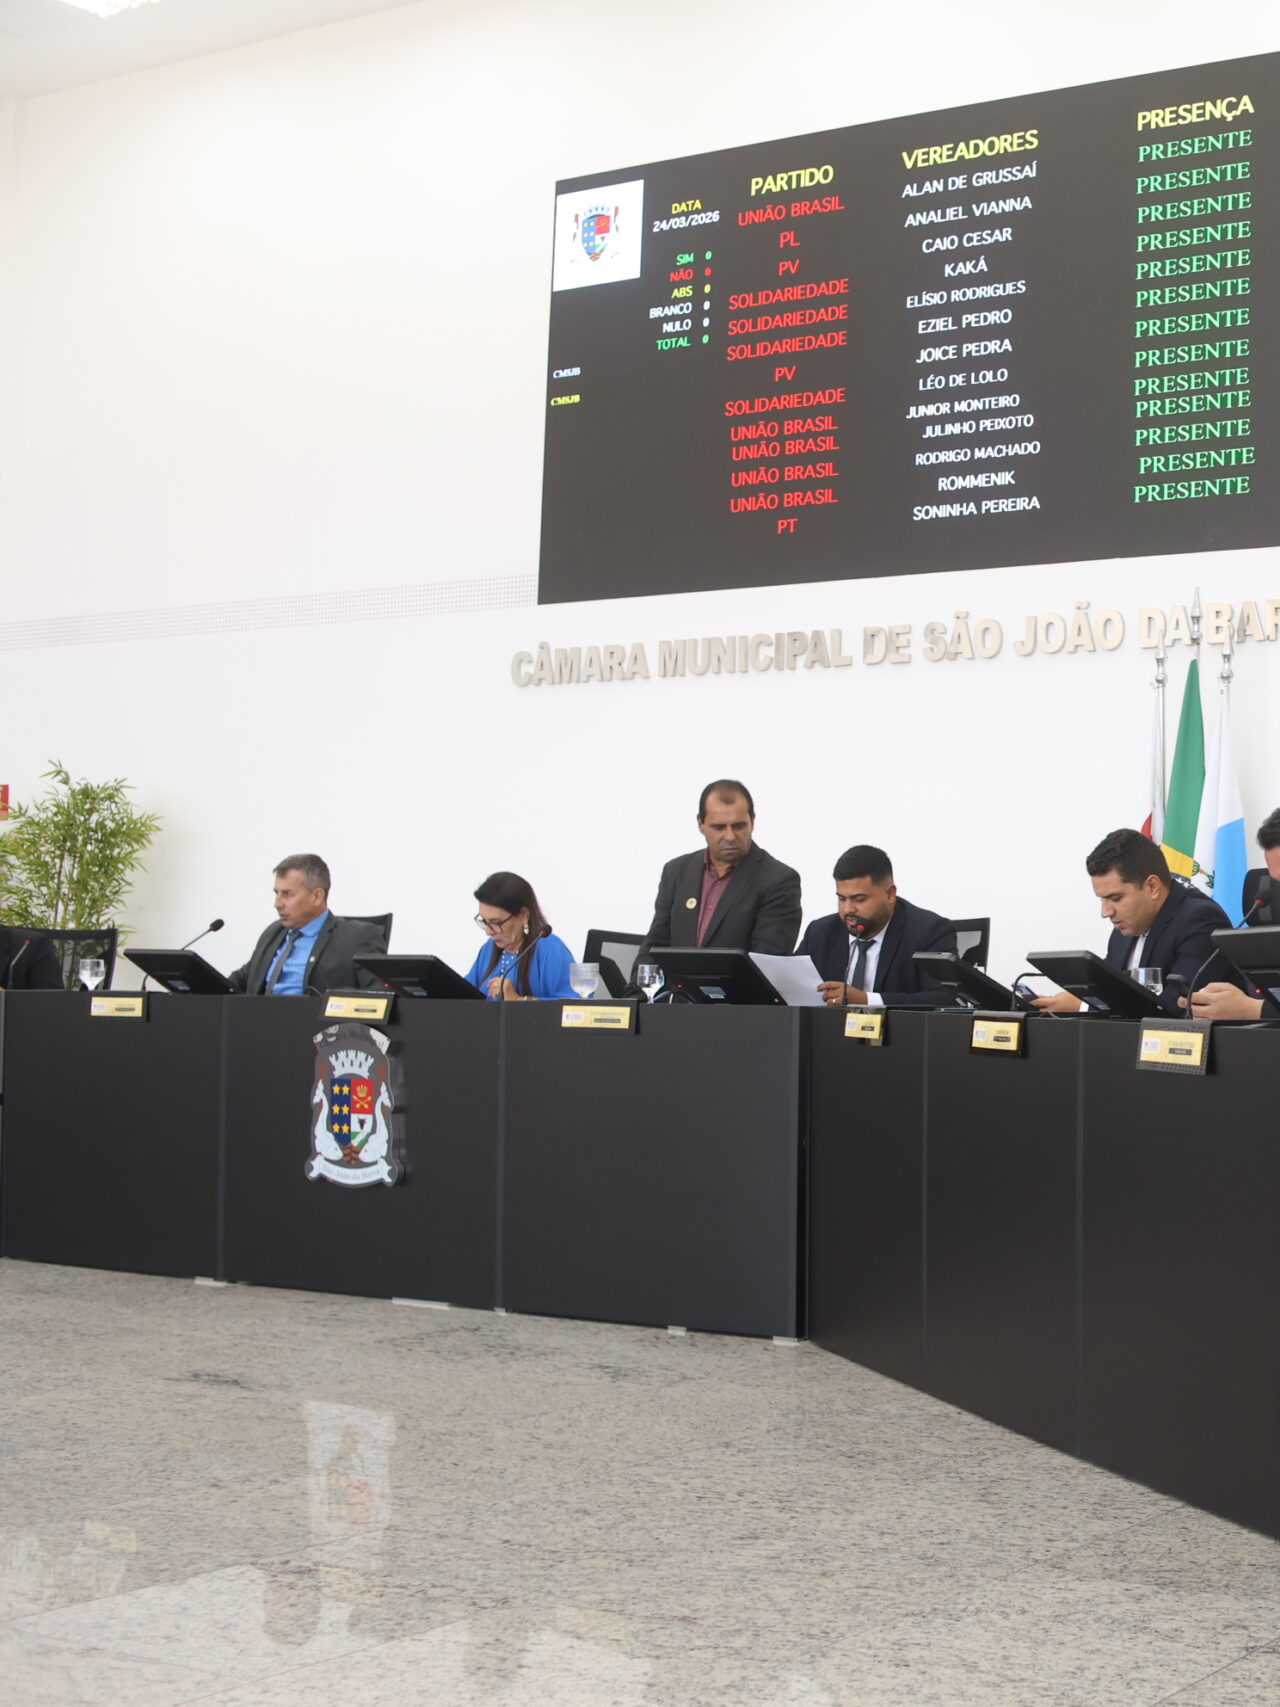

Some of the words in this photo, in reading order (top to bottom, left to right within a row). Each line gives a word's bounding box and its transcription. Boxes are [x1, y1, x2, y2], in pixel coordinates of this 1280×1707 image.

[1137, 95, 1254, 131] PRESENÇA
[902, 129, 1038, 169] VEREADORES
[1138, 130, 1252, 162] PRESENTE
[751, 165, 834, 196] PARTIDO
[902, 179, 944, 198] ALAN
[948, 175, 967, 190] DE
[972, 160, 1037, 186] GRUSSAÍ
[1136, 162, 1250, 194] PRESENTE
[672, 199, 701, 214] DATA
[738, 204, 787, 226] UNIÃO
[790, 196, 845, 217] BRASIL
[904, 206, 968, 227] ANALIEL
[972, 196, 1032, 216] VIANNA
[1138, 192, 1252, 223] PRESENTE
[653, 210, 720, 232] 24/03/2026
[779, 231, 801, 248] PL
[922, 235, 958, 253] CAIO
[963, 227, 1012, 247] CESAR
[1136, 221, 1251, 252] PRESENTE
[676, 253, 694, 265] SIM
[705, 251, 712, 260] 0
[778, 259, 800, 276] PV
[945, 255, 988, 277] KAKÁ
[1136, 249, 1251, 280] PRESENTE
[670, 268, 695, 282] NÃO
[705, 267, 712, 276] 0
[671, 285, 693, 298] ABS
[704, 284, 711, 293] 0
[729, 278, 849, 310] SOLIDARIEDADE
[906, 291, 947, 308] ELÍSIO
[951, 280, 1026, 302] RODRIGUES
[1136, 278, 1250, 307] PRESENTE
[649, 302, 692, 319] BRANCO
[703, 301, 710, 310] 0
[728, 304, 848, 335] SOLIDARIEDADE
[918, 317, 958, 334] EZIEL
[962, 309, 1012, 328] PEDRO
[1135, 308, 1250, 338] PRESENTE
[663, 319, 692, 333] NULO
[703, 317, 709, 327] 0
[656, 336, 691, 350] TOTAL
[702, 334, 709, 344] 0
[726, 331, 848, 360] SOLIDARIEDADE
[916, 345, 958, 363] JOICE
[962, 339, 1012, 357] PEDRA
[1135, 339, 1250, 368] PRESENTE
[553, 367, 581, 378] CMSJB
[775, 366, 797, 382] PV
[919, 374, 945, 390] LÉO
[949, 373, 967, 387] DE
[971, 368, 1008, 384] LOLO
[1134, 368, 1249, 396] PRESENTE
[551, 395, 580, 406] CMSJB
[724, 387, 846, 416] SOLIDARIEDADE
[906, 402, 951, 419] JUNIOR
[954, 394, 1020, 413] MONTEIRO
[1136, 390, 1251, 418] PRESENTE
[731, 421, 780, 441] UNIÃO
[783, 416, 838, 435] BRASIL
[922, 420, 976, 438] JULINHO
[979, 414, 1034, 431] PEIXOTO
[1136, 419, 1251, 446] PRESENTE
[732, 441, 782, 461] UNIÃO
[785, 435, 840, 455] BRASIL
[916, 448, 971, 465] RODRIGO
[974, 441, 1040, 459] MACHADO
[1139, 447, 1255, 474] PRESENTE
[731, 467, 781, 487] UNIÃO
[784, 462, 839, 481] BRASIL
[938, 471, 1015, 491] ROMMENIK
[730, 492, 780, 513] UNIÃO
[783, 489, 838, 507] BRASIL
[1134, 476, 1250, 503] PRESENTE
[913, 502, 977, 520] SONINHA
[981, 496, 1040, 514] PEREIRA
[778, 518, 799, 534] PT
[511, 642, 649, 687] CÂMARA
[658, 629, 853, 678] MUNICIPAL
[863, 624, 912, 665] DE
[923, 611, 1004, 661] SÃO
[1013, 601, 1125, 656] JOÃO
[1139, 606, 1194, 649] DA
